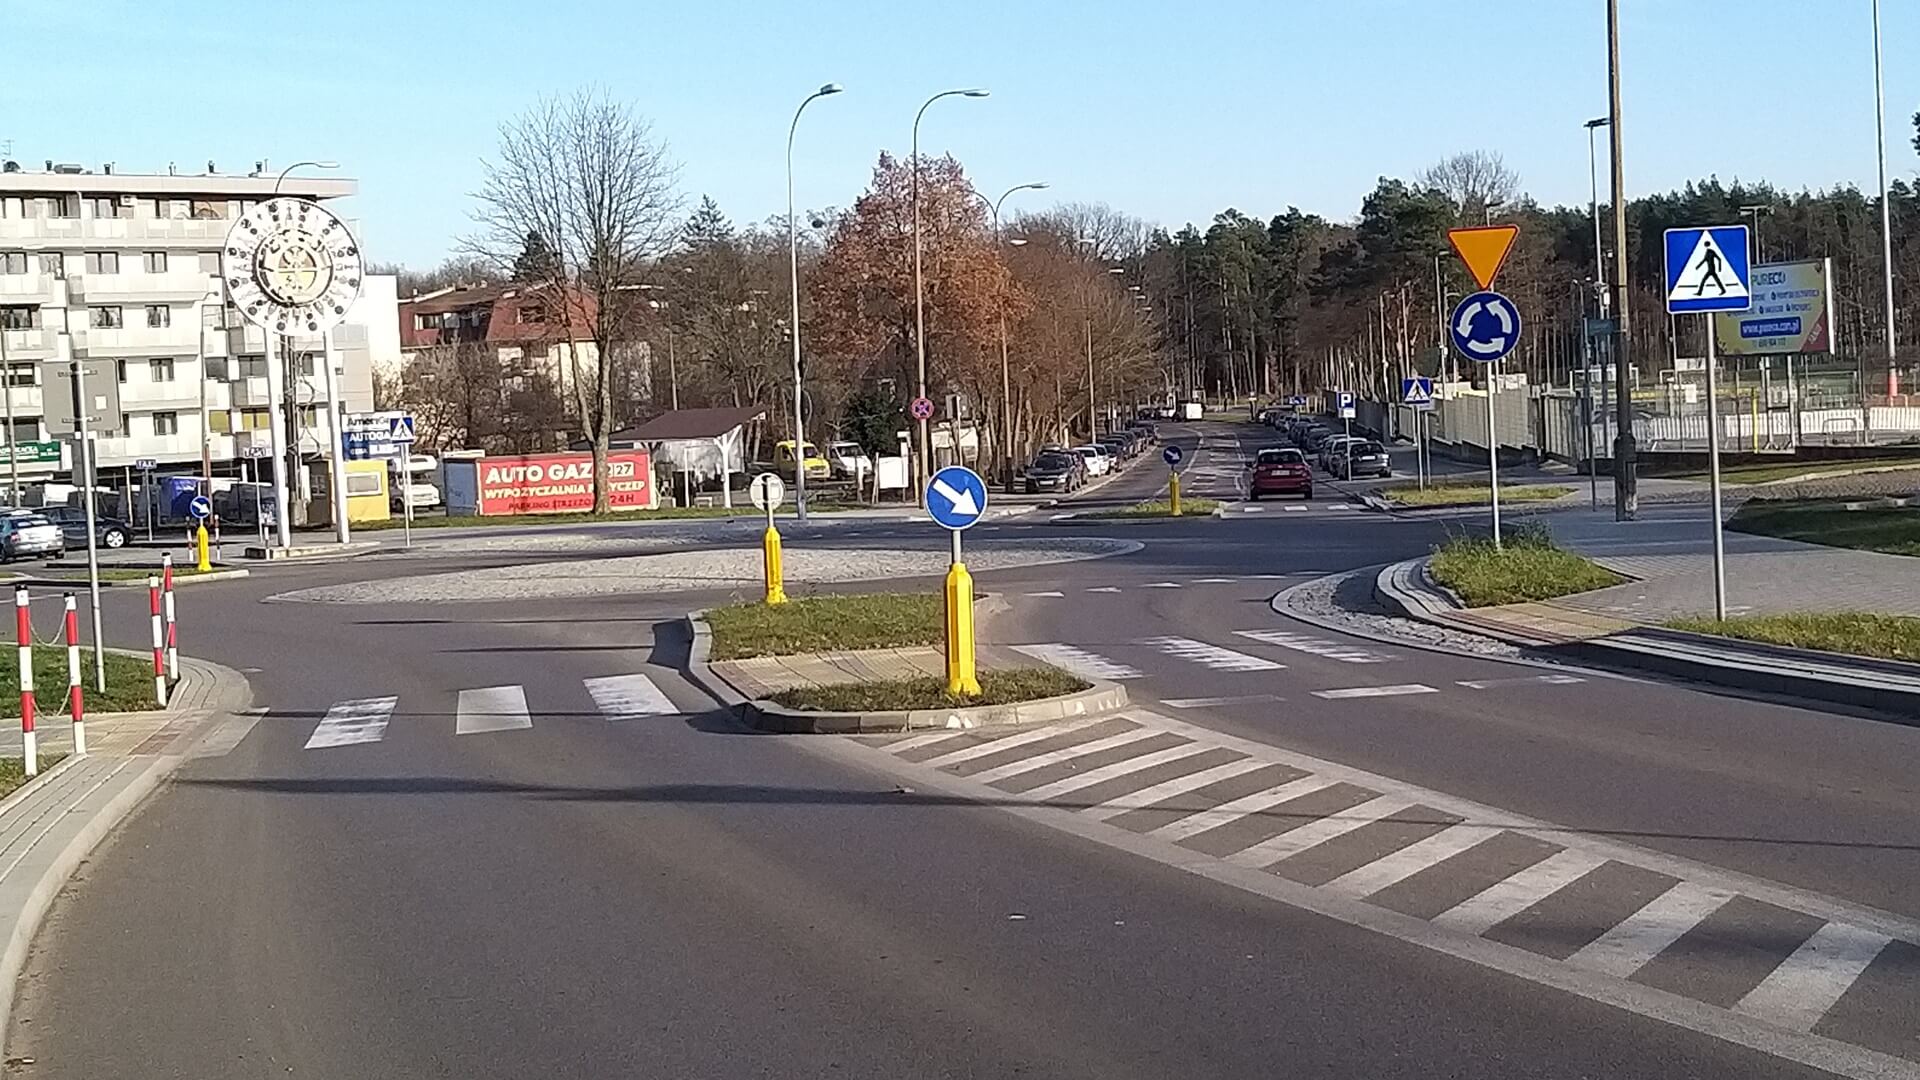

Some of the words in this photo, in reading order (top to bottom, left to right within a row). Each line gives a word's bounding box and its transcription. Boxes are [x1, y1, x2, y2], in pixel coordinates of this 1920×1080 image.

[1341, 393, 1351, 407] P
[349, 431, 391, 442] AUTOGA
[485, 464, 544, 484] AUTO
[548, 462, 593, 481] GAZ
